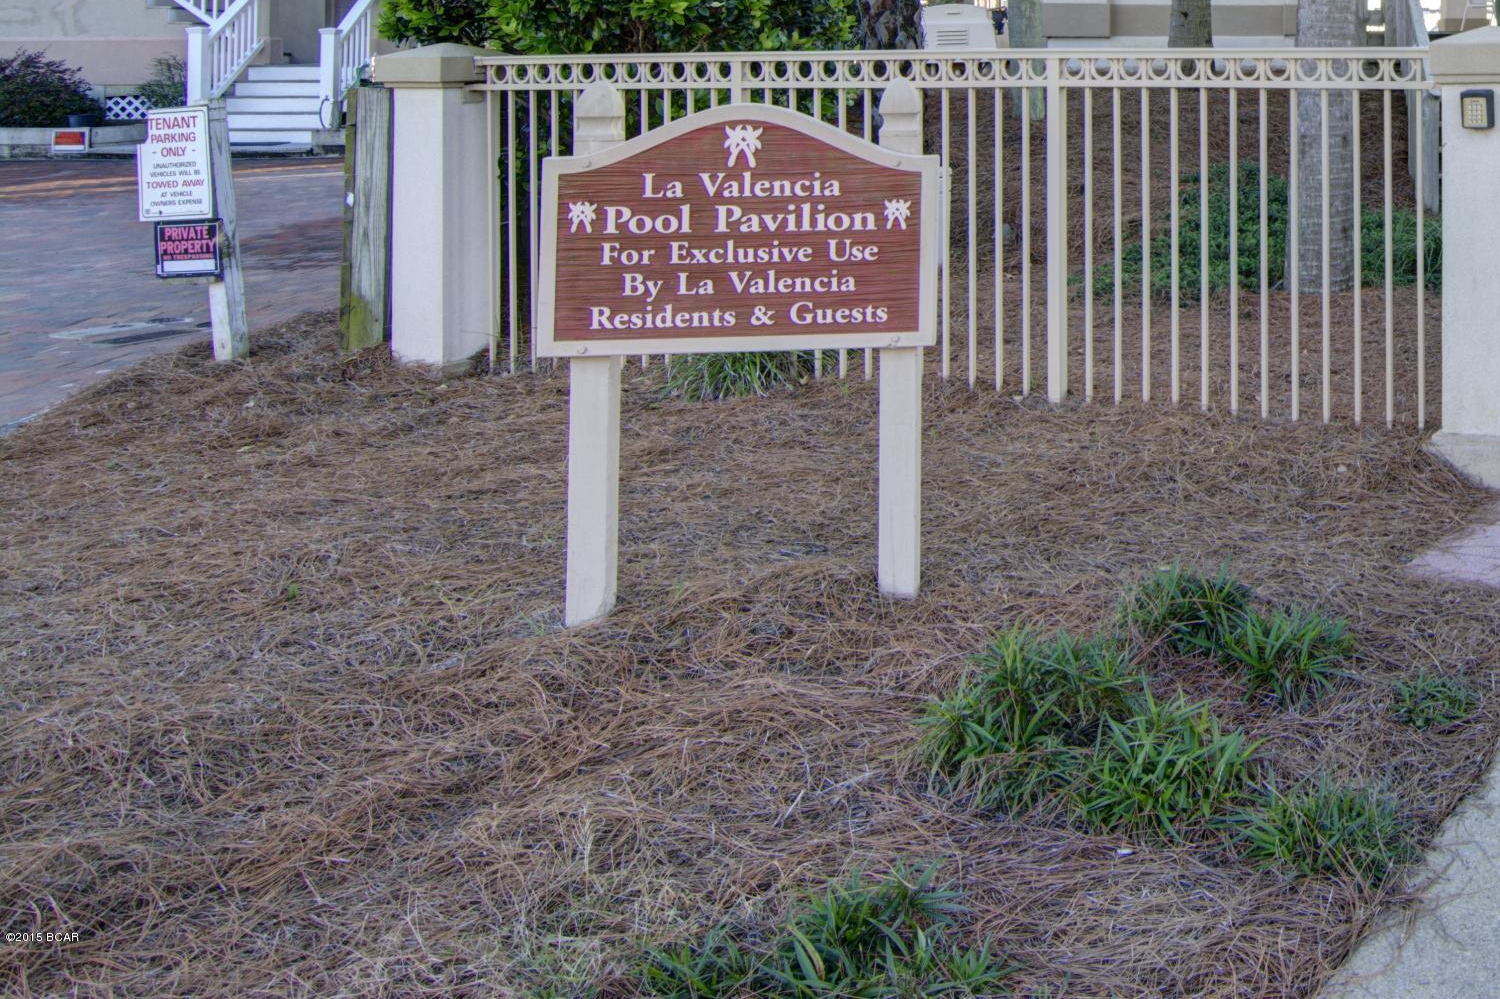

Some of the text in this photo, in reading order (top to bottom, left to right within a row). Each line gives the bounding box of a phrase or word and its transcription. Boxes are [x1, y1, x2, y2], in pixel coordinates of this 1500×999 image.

[148, 115, 198, 131] TENANT
[151, 131, 196, 144] PARKING
[160, 146, 187, 158] ONLY
[153, 161, 197, 169] UNAUTHORIZED
[145, 179, 205, 189] TOWED AWAY
[642, 171, 841, 198] La Valencia
[177, 198, 203, 206] EXPENSE
[603, 202, 877, 235] Pool Pavilion
[164, 225, 209, 241] PRIVATE
[160, 237, 217, 254] PROPERTY
[600, 238, 879, 266] For Exclusive Use
[622, 269, 856, 302] By La Valencia
[589, 301, 889, 330] Residents & Guests
